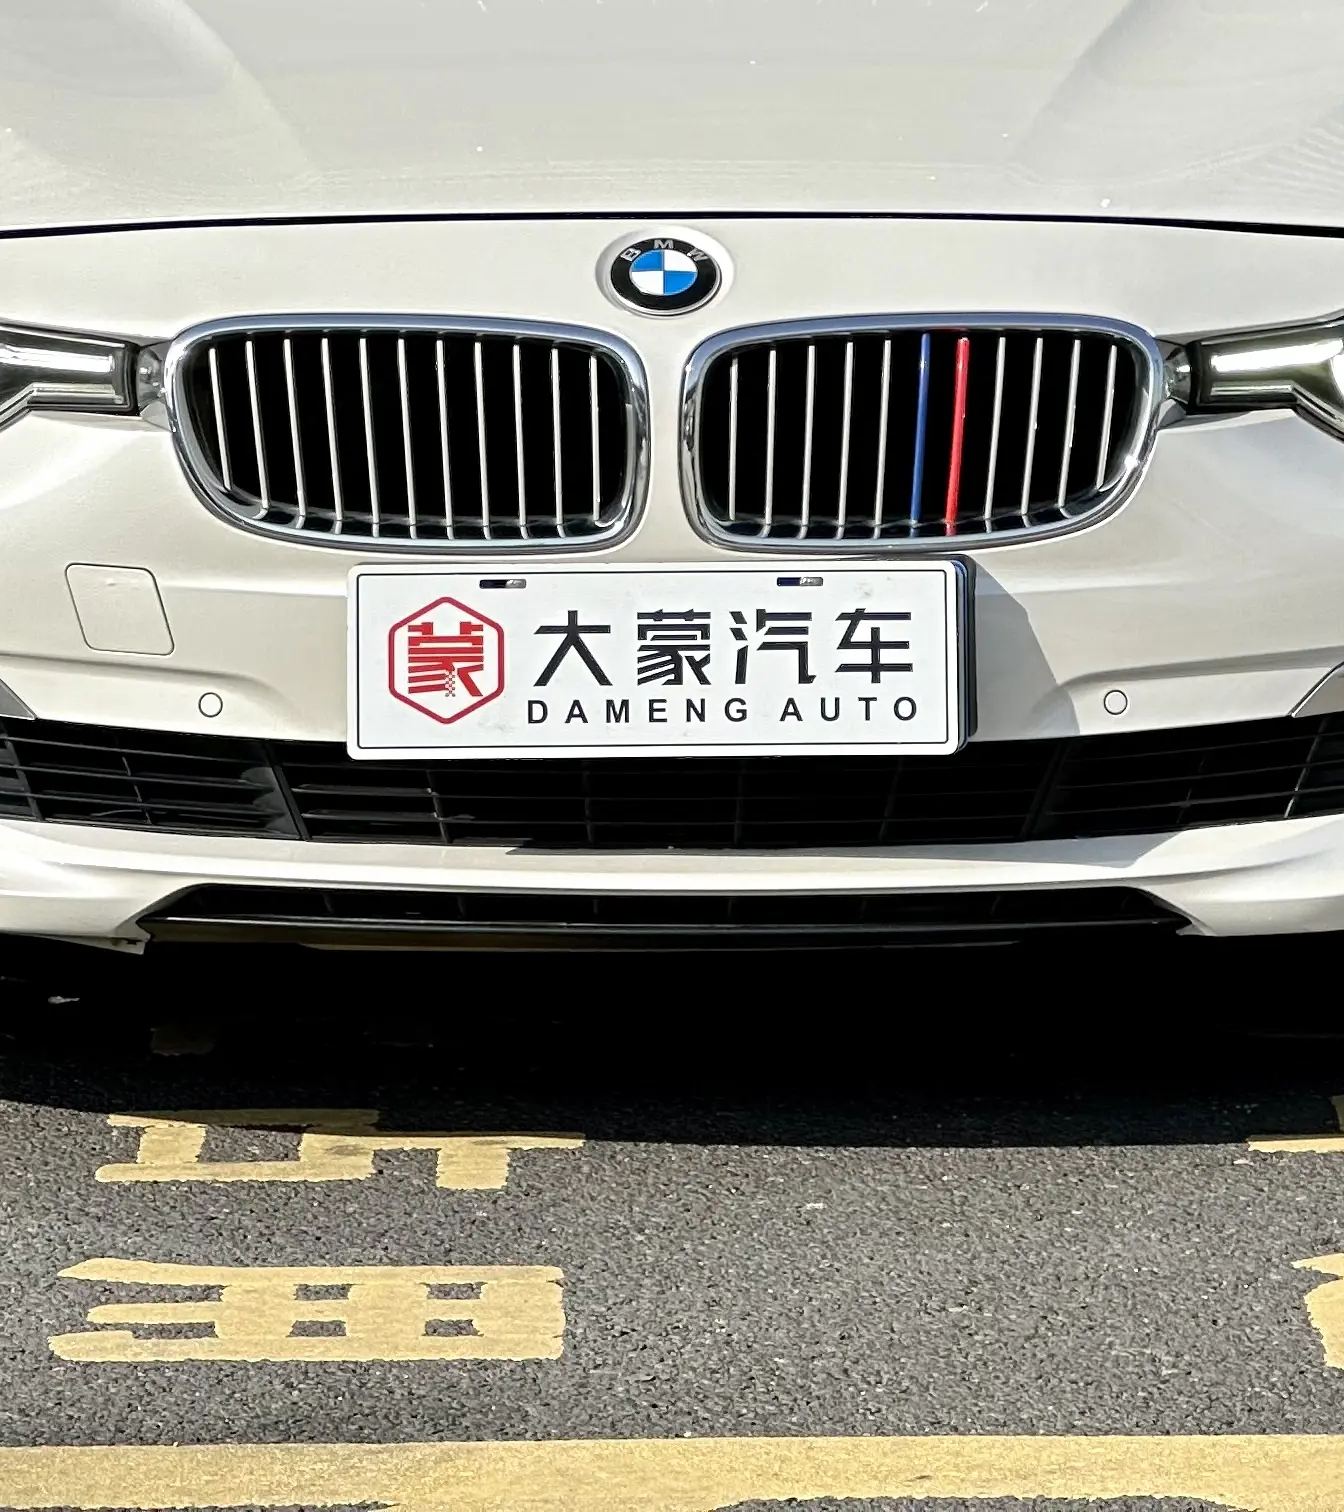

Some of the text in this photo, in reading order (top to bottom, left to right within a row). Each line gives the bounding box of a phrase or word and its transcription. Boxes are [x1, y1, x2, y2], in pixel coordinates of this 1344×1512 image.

[620, 239, 710, 262] BMW
[533, 608, 913, 687] 大蒙汽车
[527, 696, 918, 724] DAMENG AUTO
